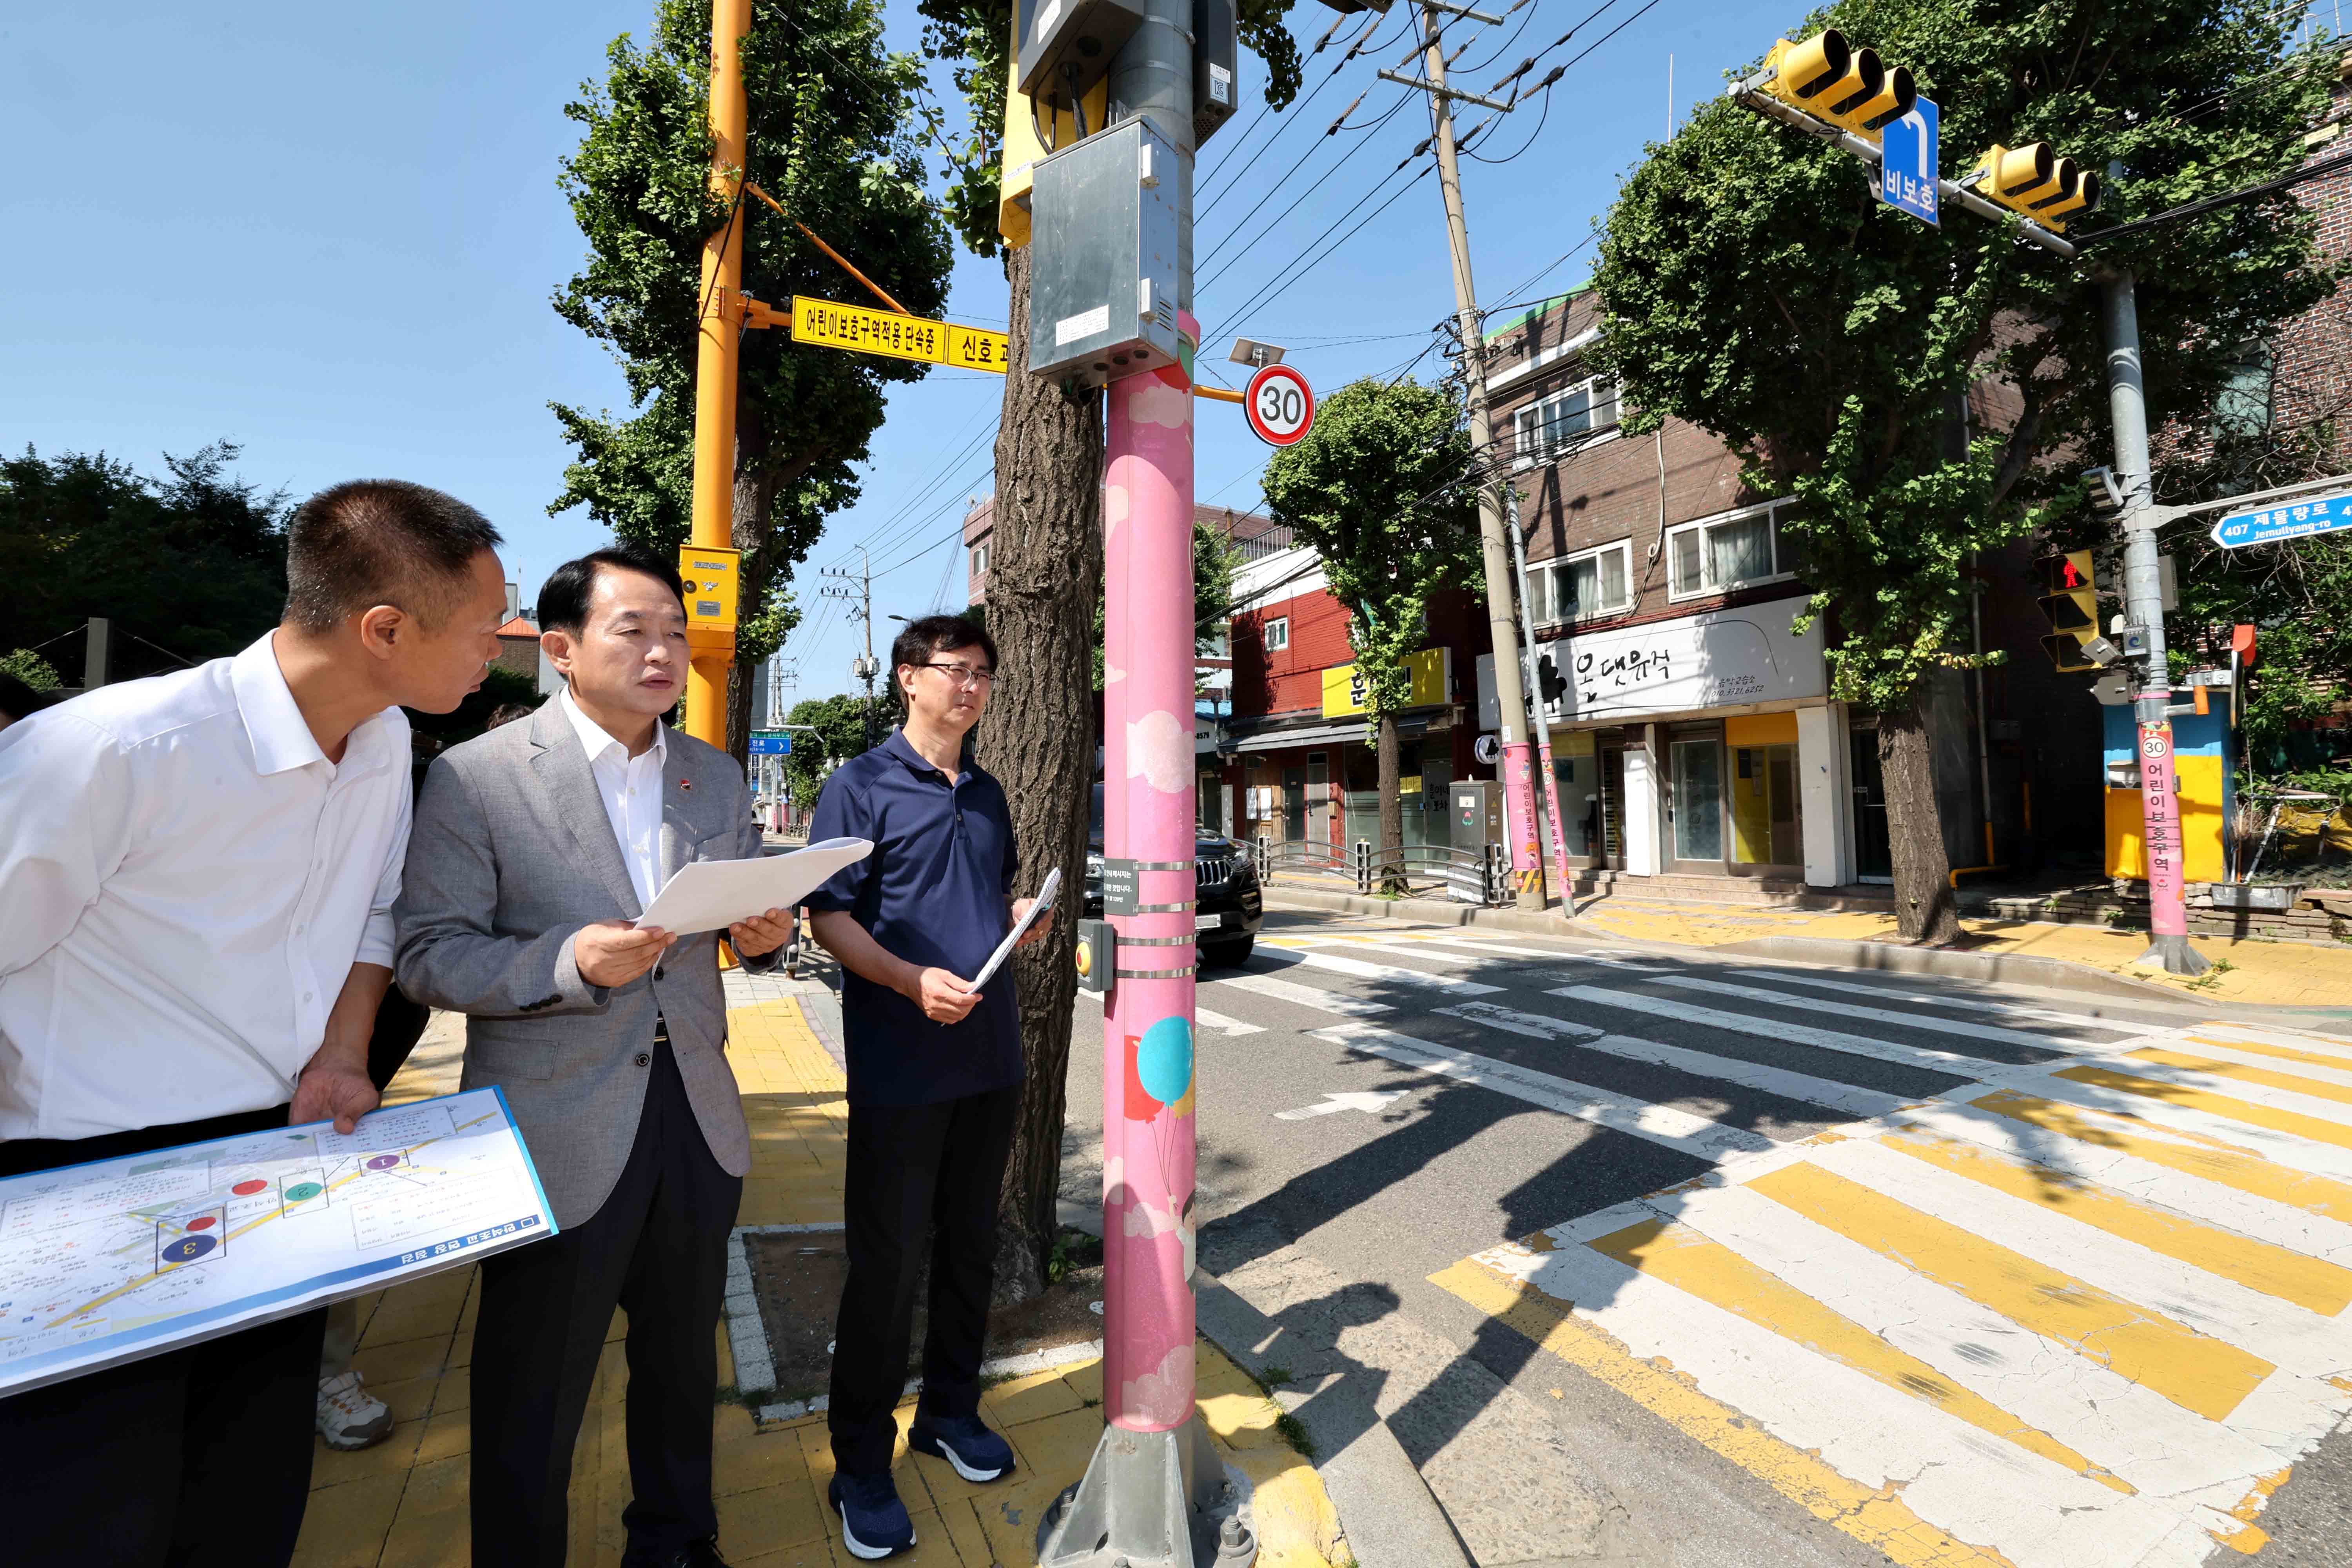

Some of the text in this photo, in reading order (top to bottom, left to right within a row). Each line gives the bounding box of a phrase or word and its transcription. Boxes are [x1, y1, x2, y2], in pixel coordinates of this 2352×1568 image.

[1886, 169, 1935, 213] 비보호
[806, 307, 934, 355] 어린이보호구역적용 단속중
[962, 335, 993, 363] 신호
[1261, 386, 1301, 425] 30
[2253, 502, 2352, 526] 제물량로 4
[2224, 524, 2249, 537] 407
[2253, 519, 2331, 541] Jemullyang-ro
[1719, 675, 1755, 688] 음악교습소
[2145, 742, 2164, 753] 30
[1523, 784, 1534, 839] 어린이보호구역
[2149, 764, 2169, 871] 어린이보호구역
[1112, 884, 1132, 893] 것입니다.
[297, 1187, 309, 1198] 2
[183, 1241, 196, 1255] 3
[434, 1240, 461, 1254] 현장
[401, 1249, 428, 1265] 점검
